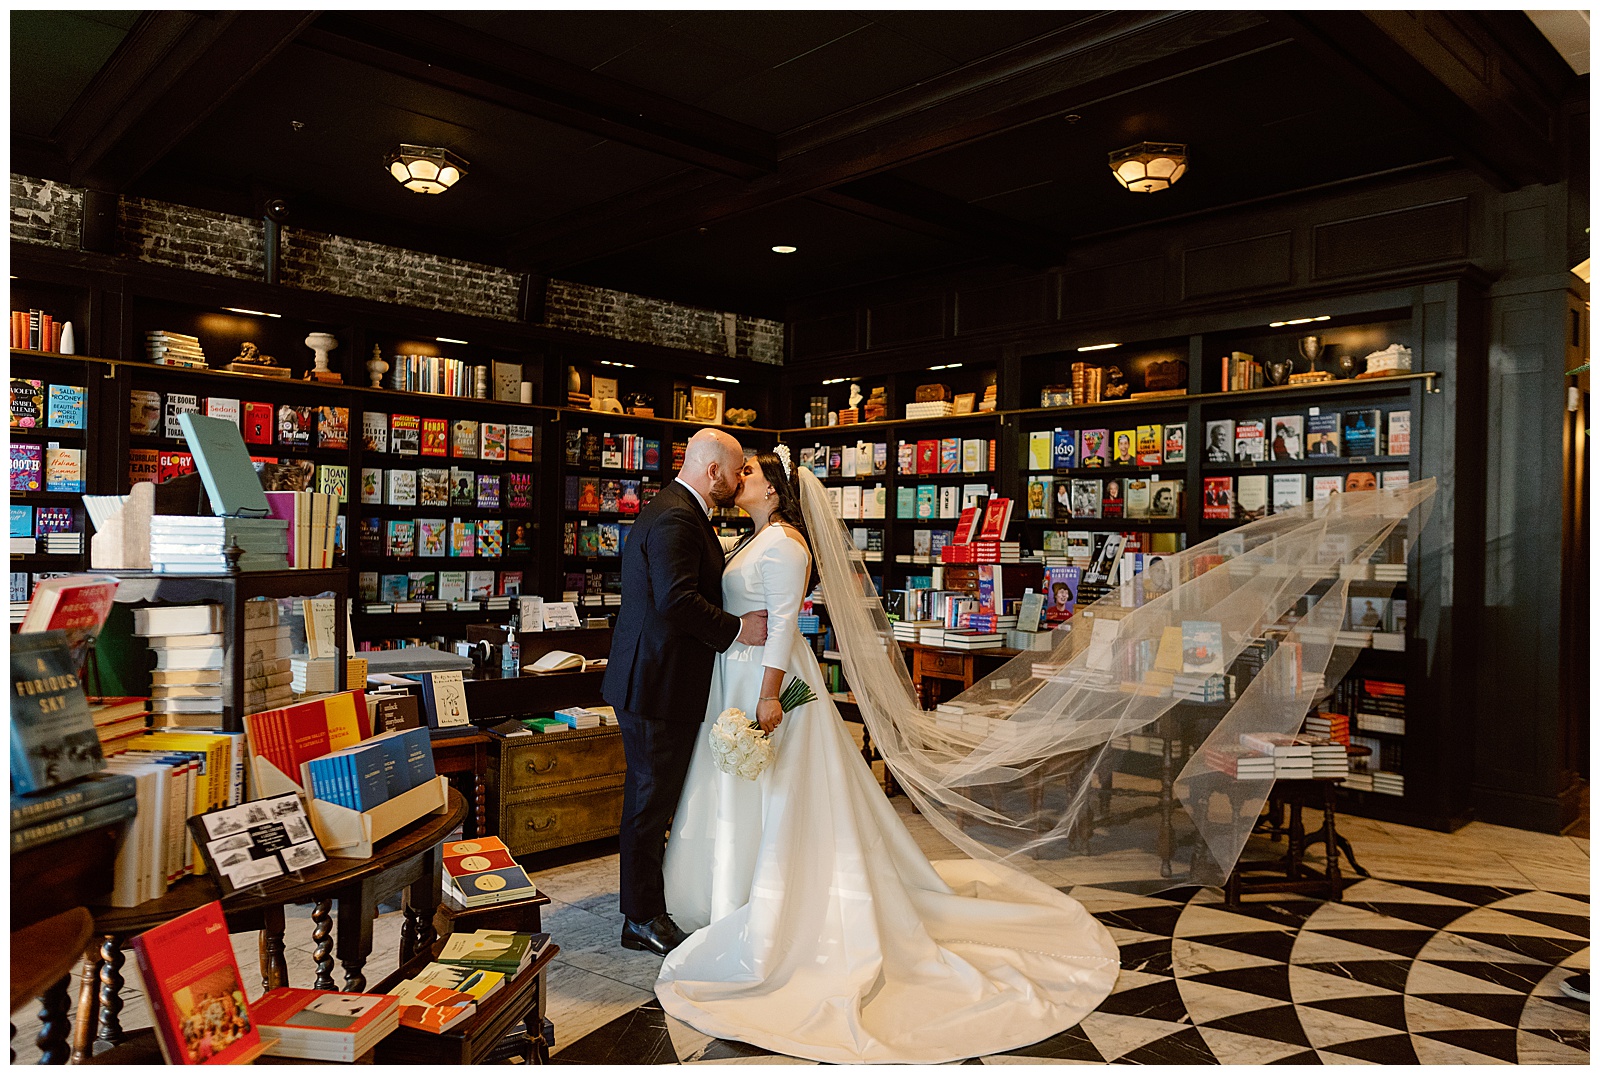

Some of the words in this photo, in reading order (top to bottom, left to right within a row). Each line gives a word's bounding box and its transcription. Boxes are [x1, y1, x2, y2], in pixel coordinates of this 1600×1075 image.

[178, 396, 196, 404] BOOKS
[210, 404, 237, 414] Sedaris
[293, 431, 310, 440] Family
[1054, 443, 1074, 457] 1619
[51, 456, 77, 468] Italian
[130, 454, 157, 462] AZORBLADE
[324, 468, 347, 482] JOAN
[1030, 509, 1048, 517] WILL
[66, 616, 93, 626] DAYS
[36, 658, 47, 672] A
[16, 674, 78, 696] FURIOUS
[39, 695, 66, 713] SKY
[329, 732, 349, 740] ONOMA
[21, 798, 64, 817] FURIOUS
[64, 793, 83, 804] SKY
[24, 822, 66, 841] FURIOUS
[66, 816, 84, 827] SKY
